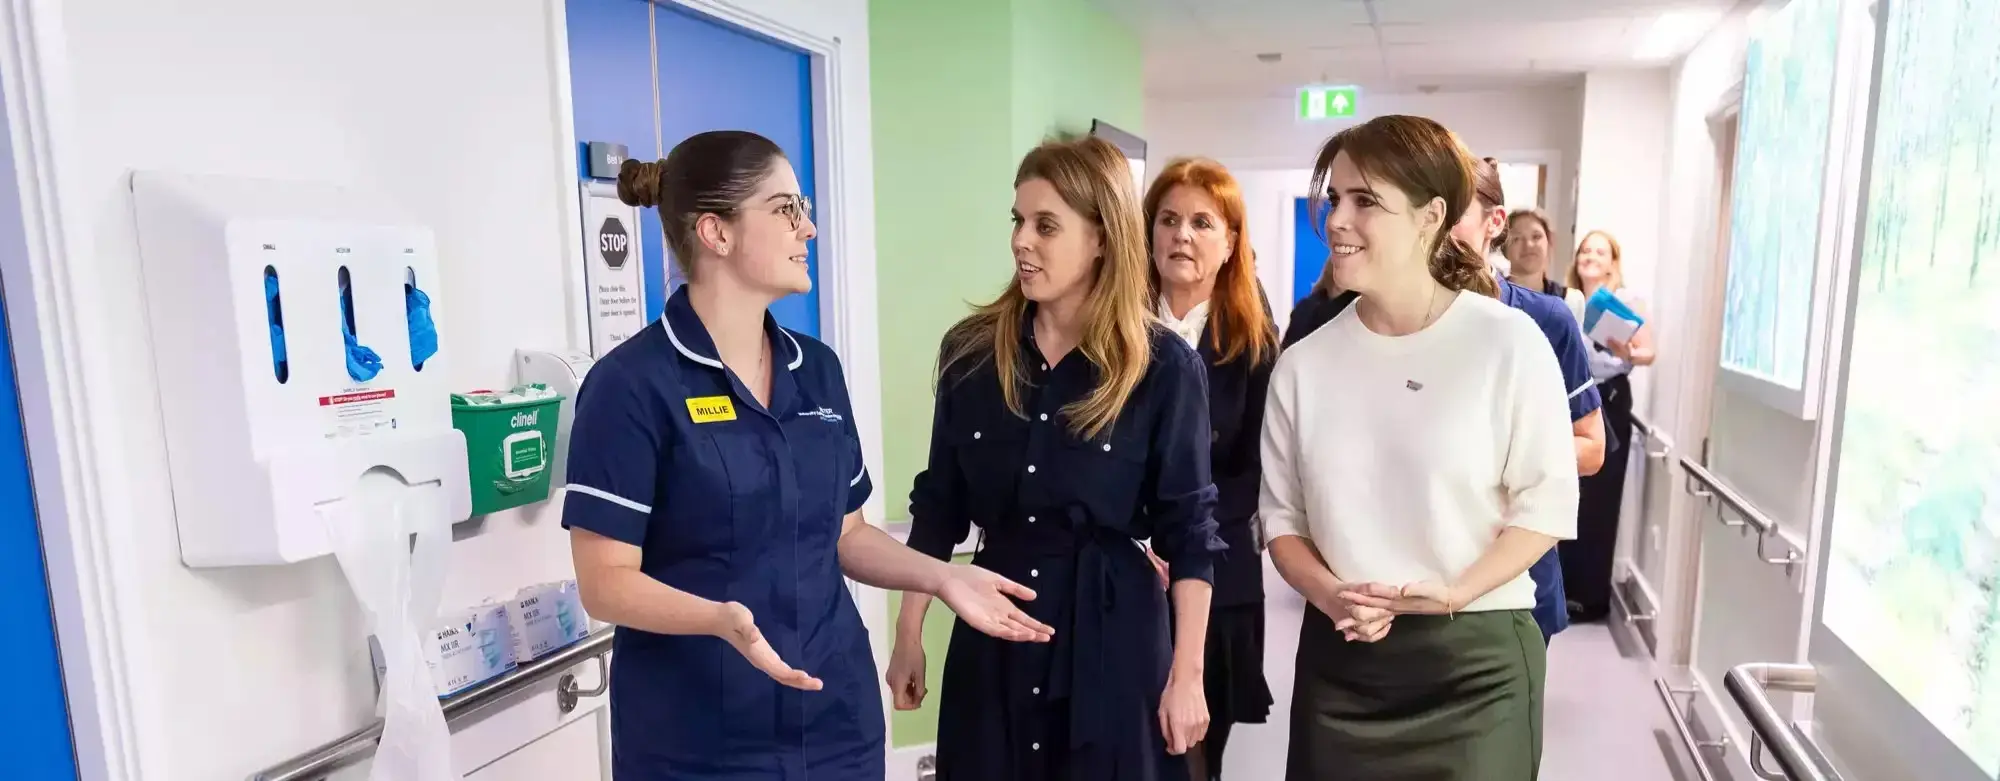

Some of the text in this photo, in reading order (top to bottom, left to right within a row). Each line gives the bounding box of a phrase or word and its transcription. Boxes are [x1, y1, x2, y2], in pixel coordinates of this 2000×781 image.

[606, 153, 618, 165] Bed
[601, 233, 627, 252] STOP
[696, 406, 729, 416] MILLIE
[510, 411, 538, 428] clinell
[440, 643, 451, 653] MX
